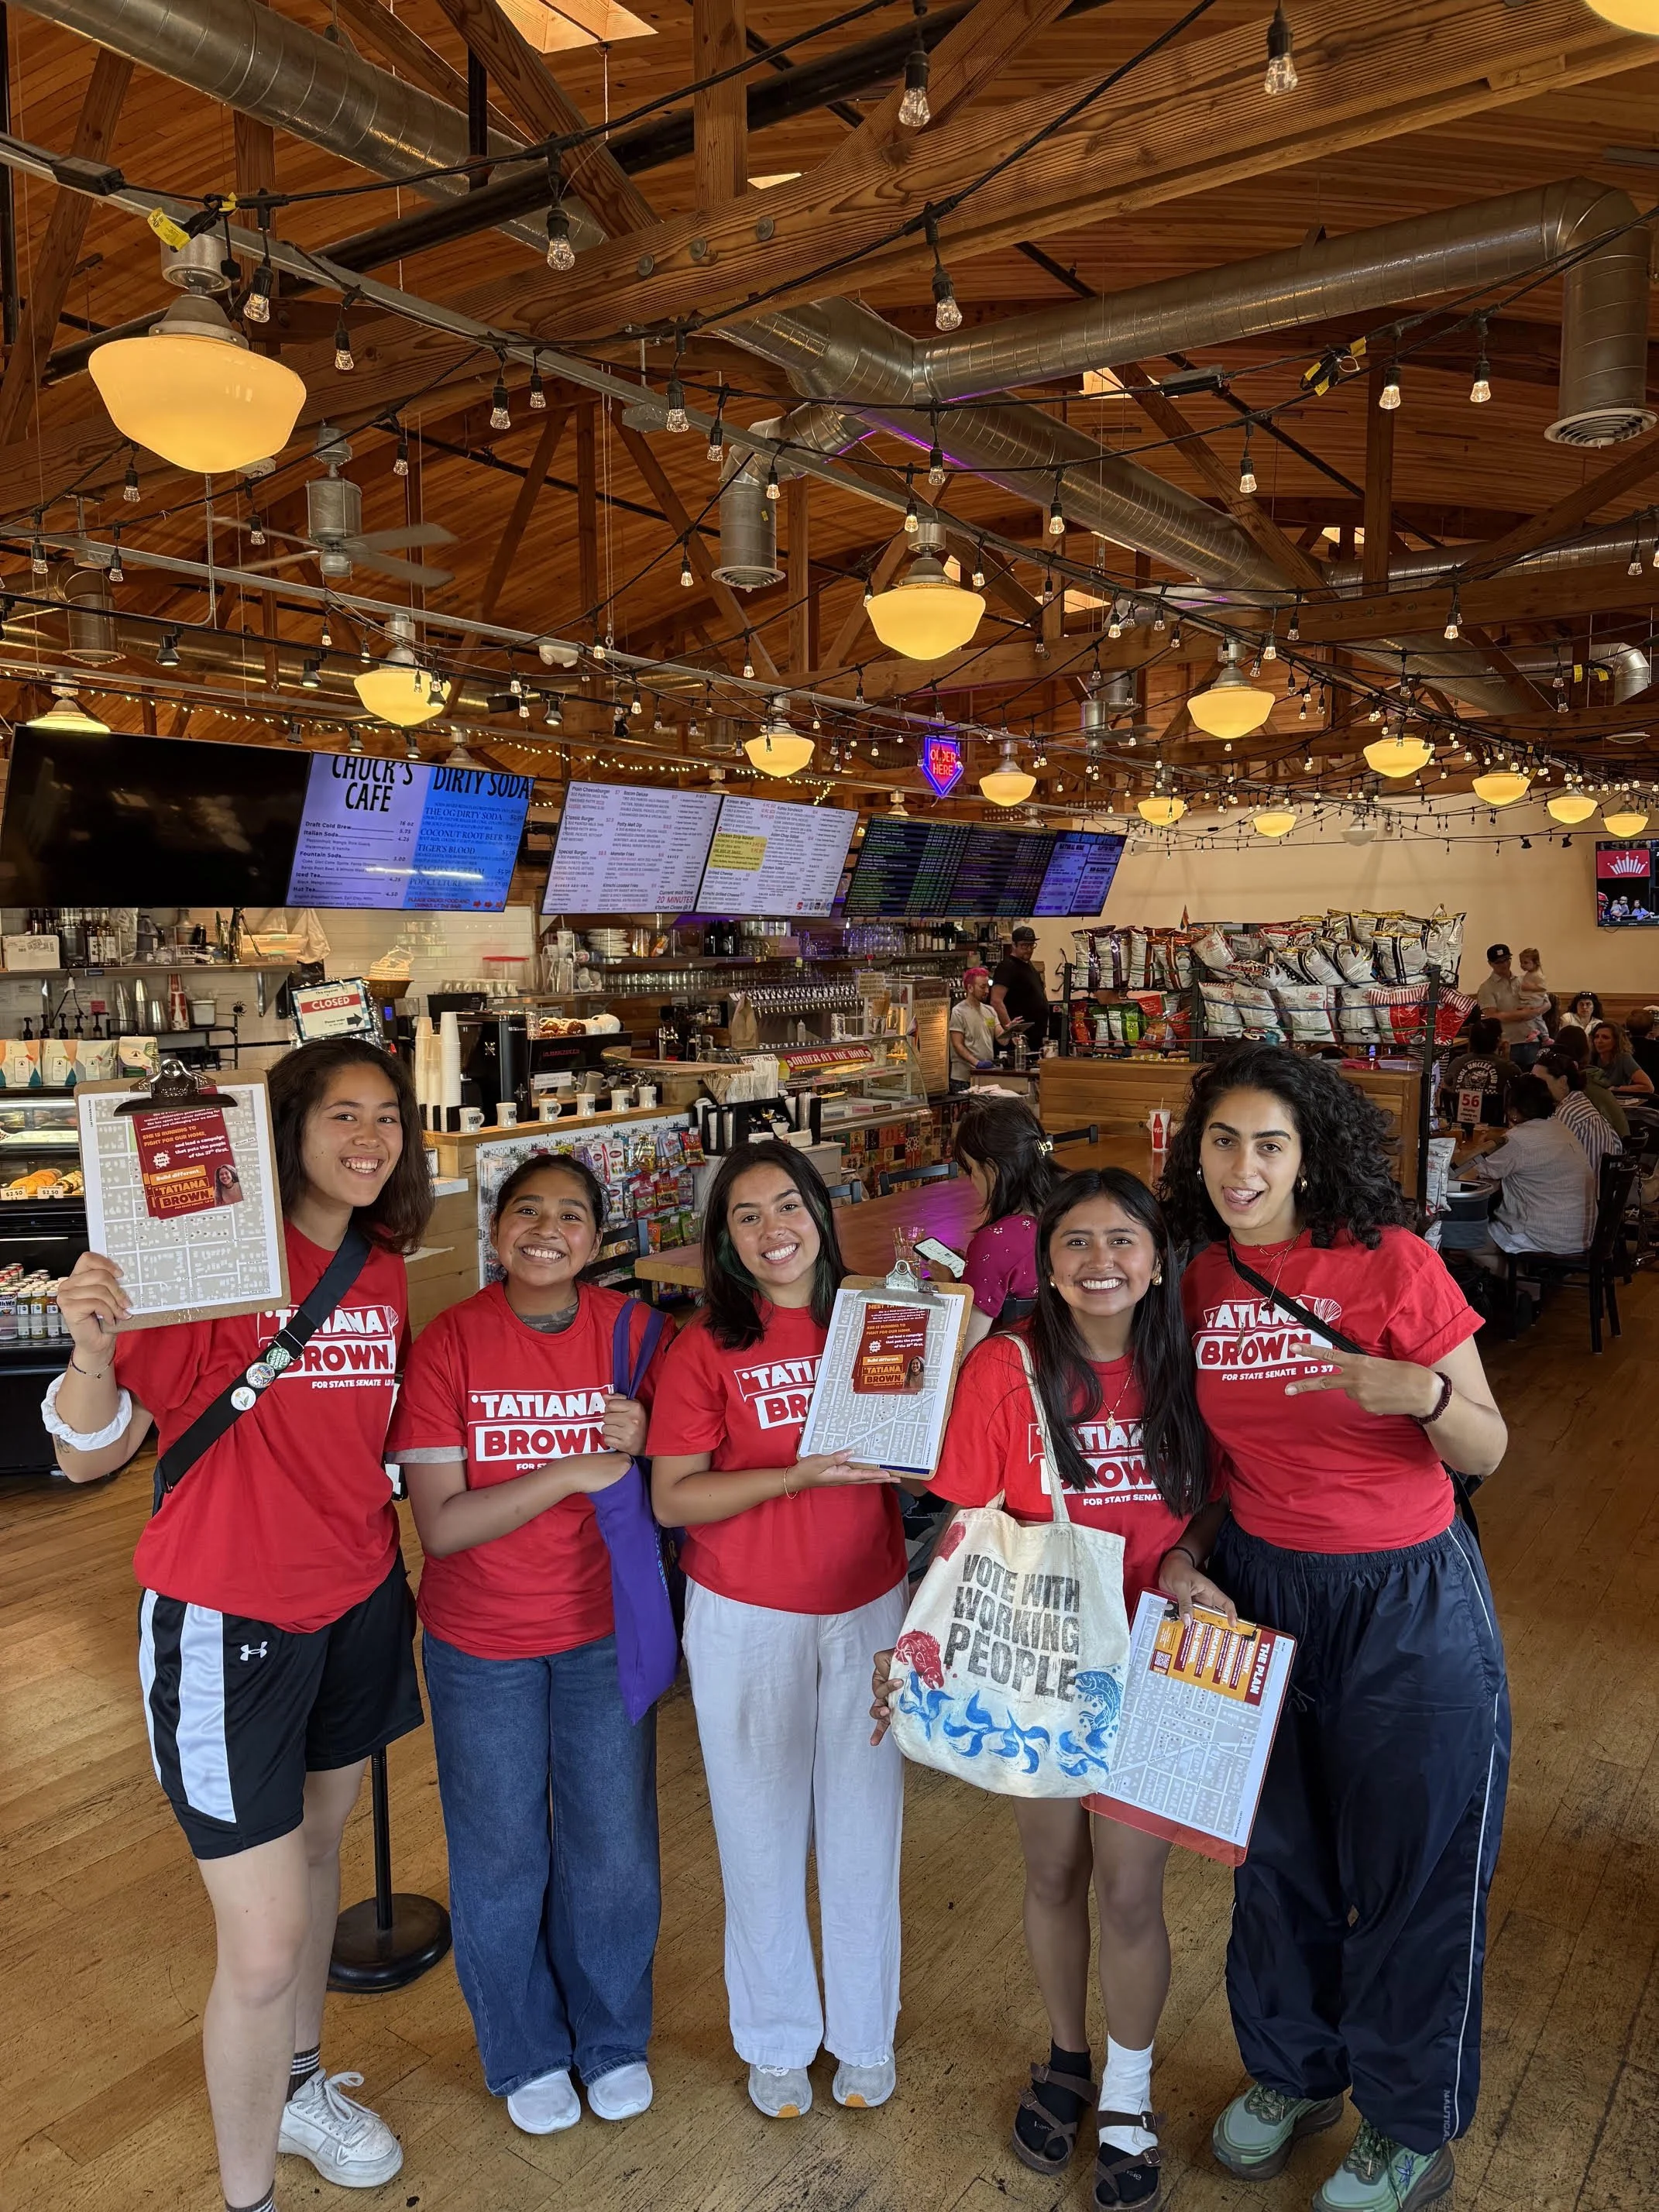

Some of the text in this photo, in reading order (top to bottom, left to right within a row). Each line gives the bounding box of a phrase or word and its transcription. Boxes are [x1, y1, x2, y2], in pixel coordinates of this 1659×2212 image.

[331, 755, 414, 785] CHUCK'S
[933, 762, 953, 776] HERE
[433, 766, 530, 799] DIRTY SODA
[345, 781, 393, 812] CAFE
[426, 807, 441, 816] THE
[456, 809, 482, 819] DIRTY
[482, 812, 503, 821] SODA
[421, 828, 503, 841] COCONUT ROOT BEER
[417, 843, 476, 854] TIGER'S BLOOD
[410, 878, 462, 888] POP CULTURE
[311, 996, 350, 1010] CLOSED
[792, 1049, 866, 1065] ORDER AT THE BAR
[1467, 1062, 1492, 1070] UNCLES
[1457, 1068, 1468, 1083] COOL
[1489, 1069, 1498, 1084] CLUB
[1462, 1094, 1479, 1108] 56
[161, 1127, 187, 1137] RUNNING
[201, 1135, 225, 1143] campaign
[143, 1139, 161, 1147] FIGHT
[171, 1169, 201, 1178] different.
[160, 1179, 207, 1195] TATIANA
[163, 1190, 213, 1206] BROWN.
[1207, 1298, 1309, 1328] ATIAN
[275, 1309, 385, 1334] TIANA
[270, 1349, 278, 1366] NEVER
[1201, 1334, 1311, 1365] BROWN
[273, 1352, 282, 1369] CROSS
[751, 1359, 822, 1389] TATI
[867, 1365, 902, 1374] TATIANA
[1239, 1372, 1263, 1380] STATE
[1265, 1368, 1297, 1379] SENATE
[1304, 1366, 1318, 1375] LD
[1321, 1365, 1334, 1373] 37
[329, 1379, 355, 1388] STATE
[867, 1374, 904, 1383] BROWN.
[480, 1392, 606, 1418] TATIANA
[484, 1427, 611, 1457] BROWN
[1104, 1495, 1131, 1504] STATE
[962, 1553, 1080, 1613] VOTE WITH
[953, 1585, 1080, 1655] WORKING
[1206, 1628, 1221, 1668] DUCATION.
[943, 1623, 1078, 1702] PEOPLE
[1221, 1633, 1239, 1685] NVIRONMENT.
[1242, 1641, 1255, 1675] CONOMY.
[1249, 1643, 1270, 1695] THE PLAN
